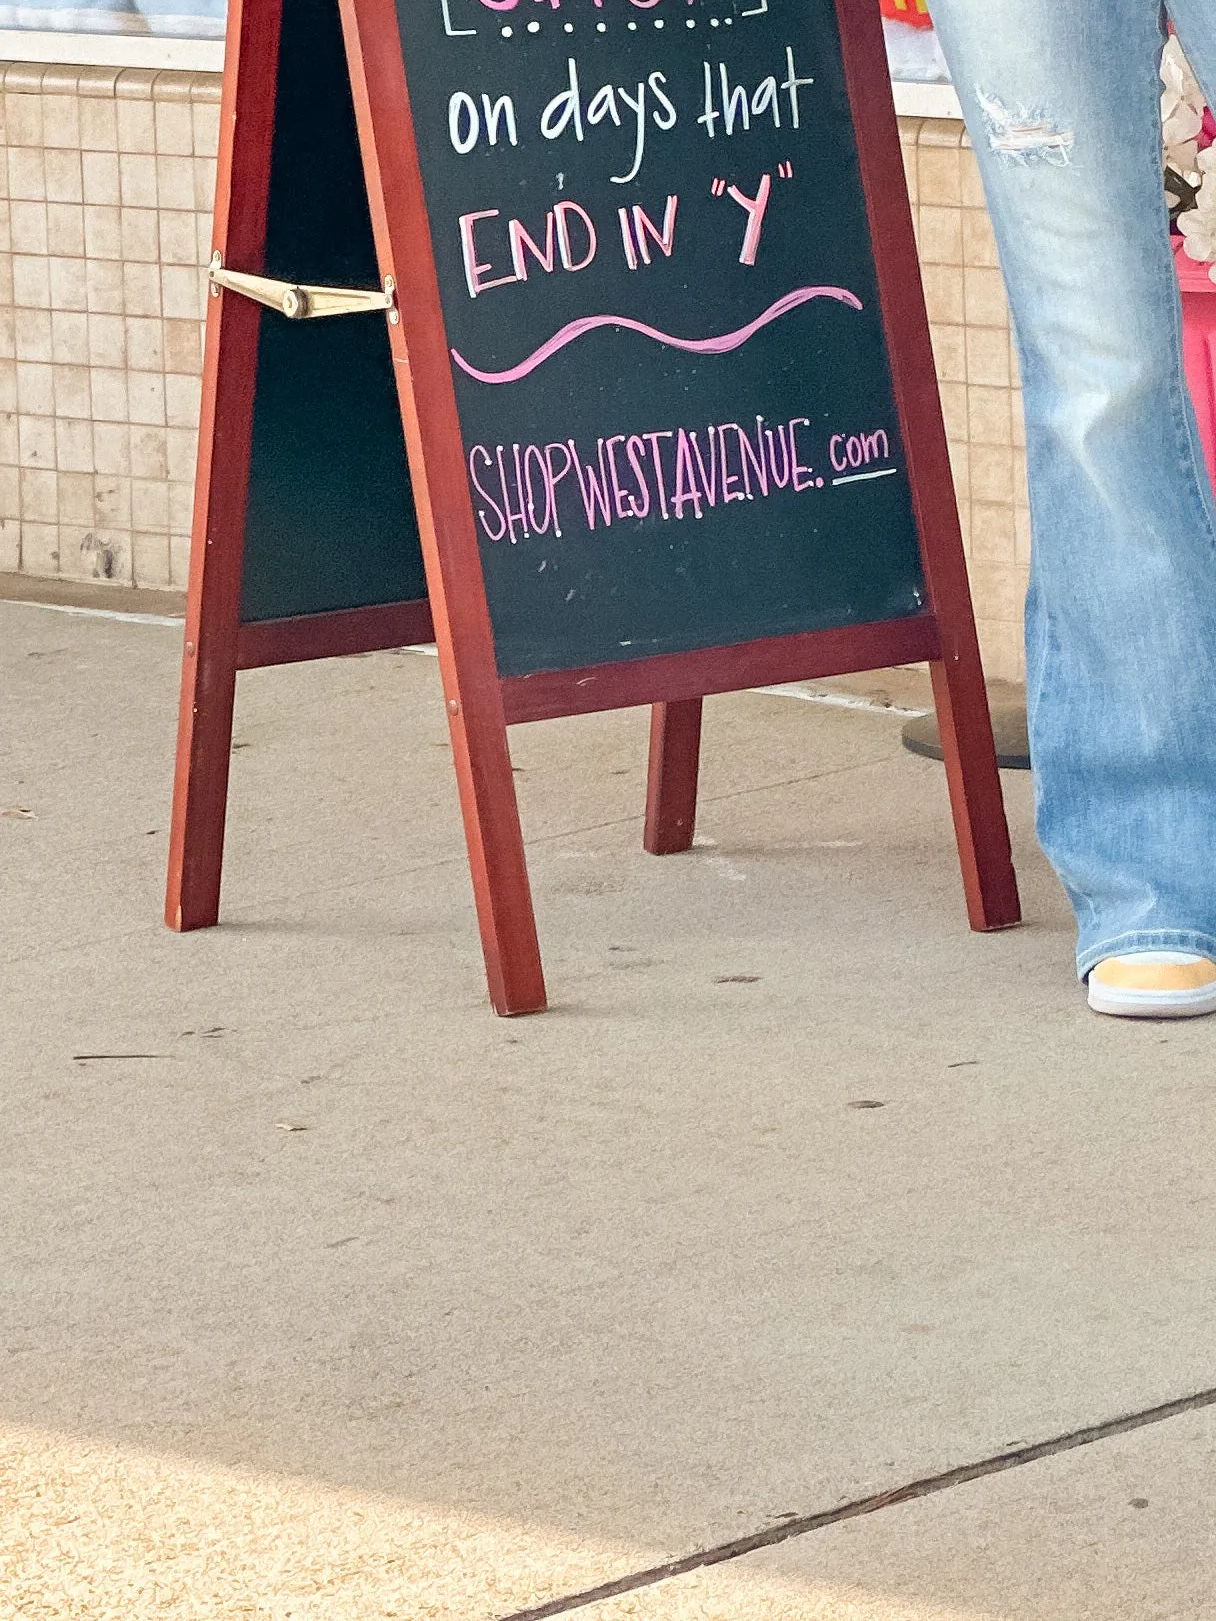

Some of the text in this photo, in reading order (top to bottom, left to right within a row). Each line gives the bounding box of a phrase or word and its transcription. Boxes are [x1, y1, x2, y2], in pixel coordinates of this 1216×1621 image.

[448, 46, 814, 184] on days that
[458, 200, 597, 298] END
[618, 195, 678, 271] IN
